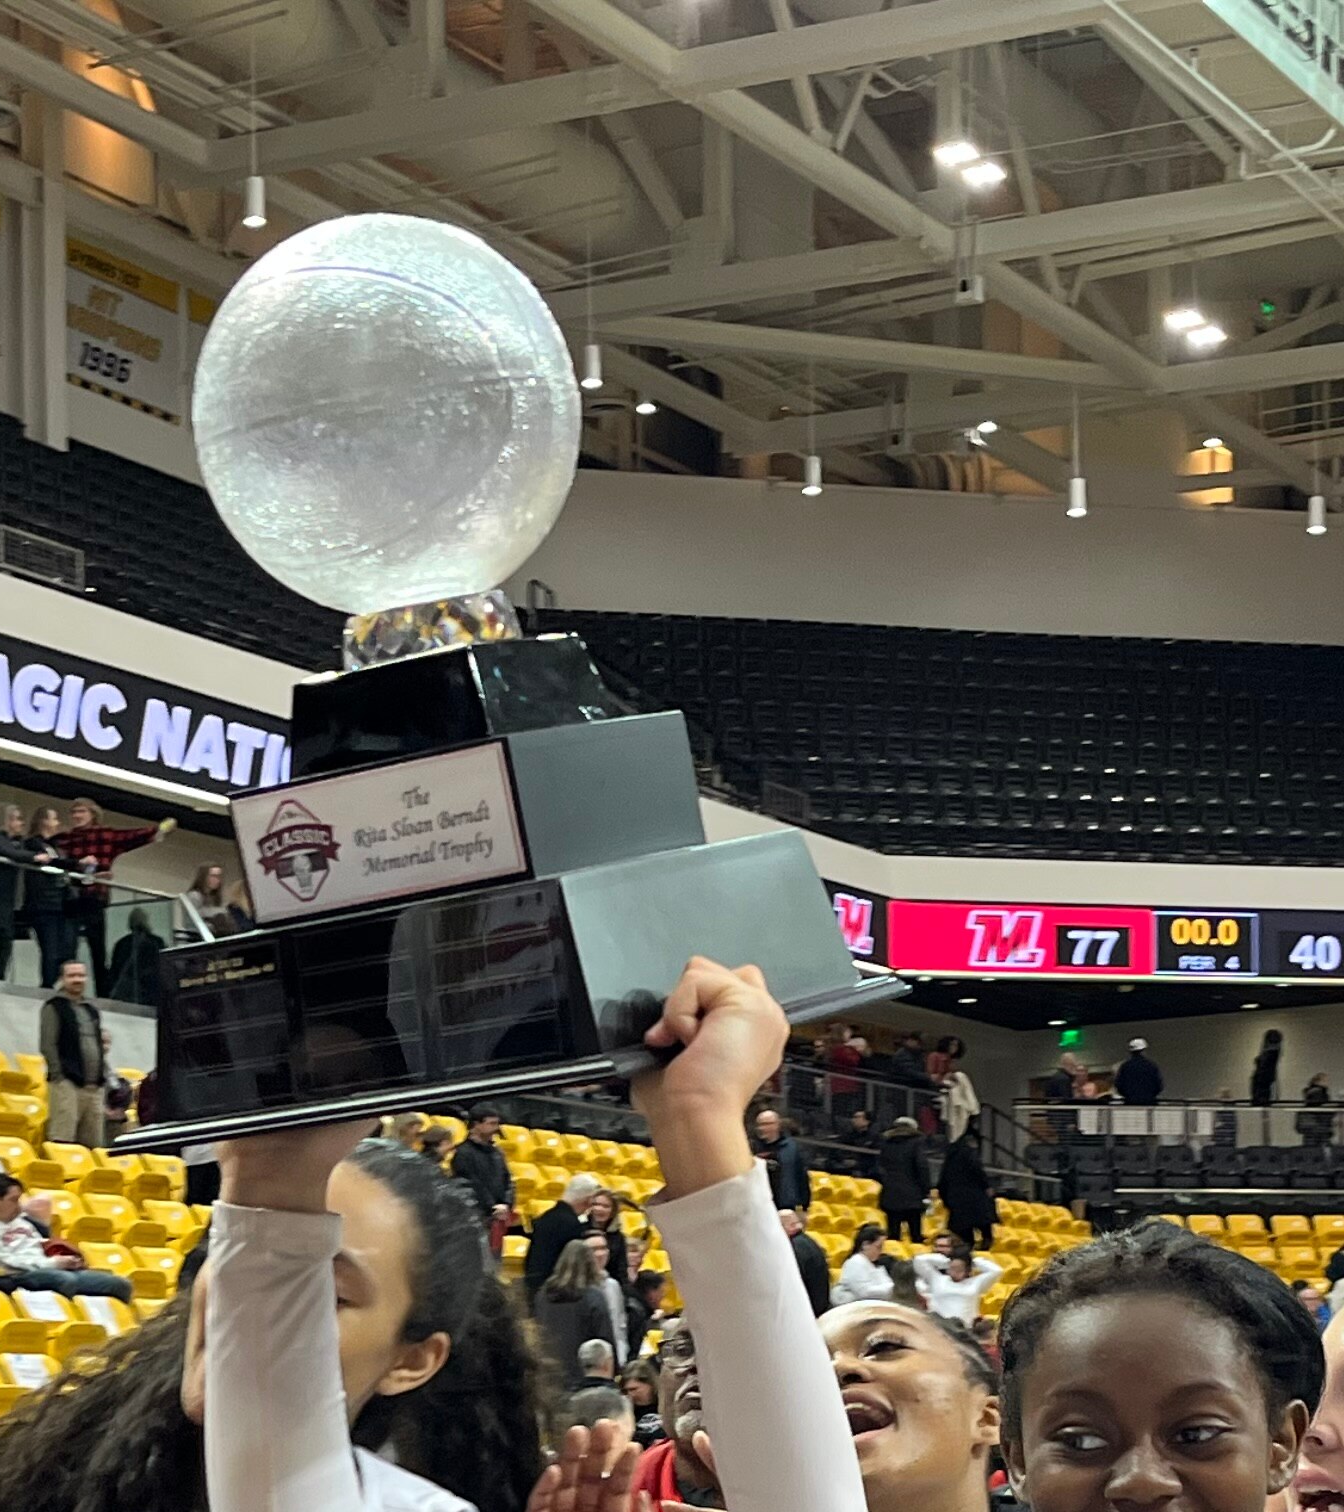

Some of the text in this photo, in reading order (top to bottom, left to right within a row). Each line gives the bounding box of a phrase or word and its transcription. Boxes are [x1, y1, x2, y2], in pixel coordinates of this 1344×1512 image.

[138, 698, 291, 789] NATI
[403, 786, 431, 808] The
[391, 814, 433, 841] Sloan
[362, 830, 494, 876] Memorial Trophy
[1170, 917, 1240, 946] 00.0
[1067, 930, 1120, 966] 77
[1224, 955, 1241, 970] 4
[1289, 934, 1342, 972] 40
